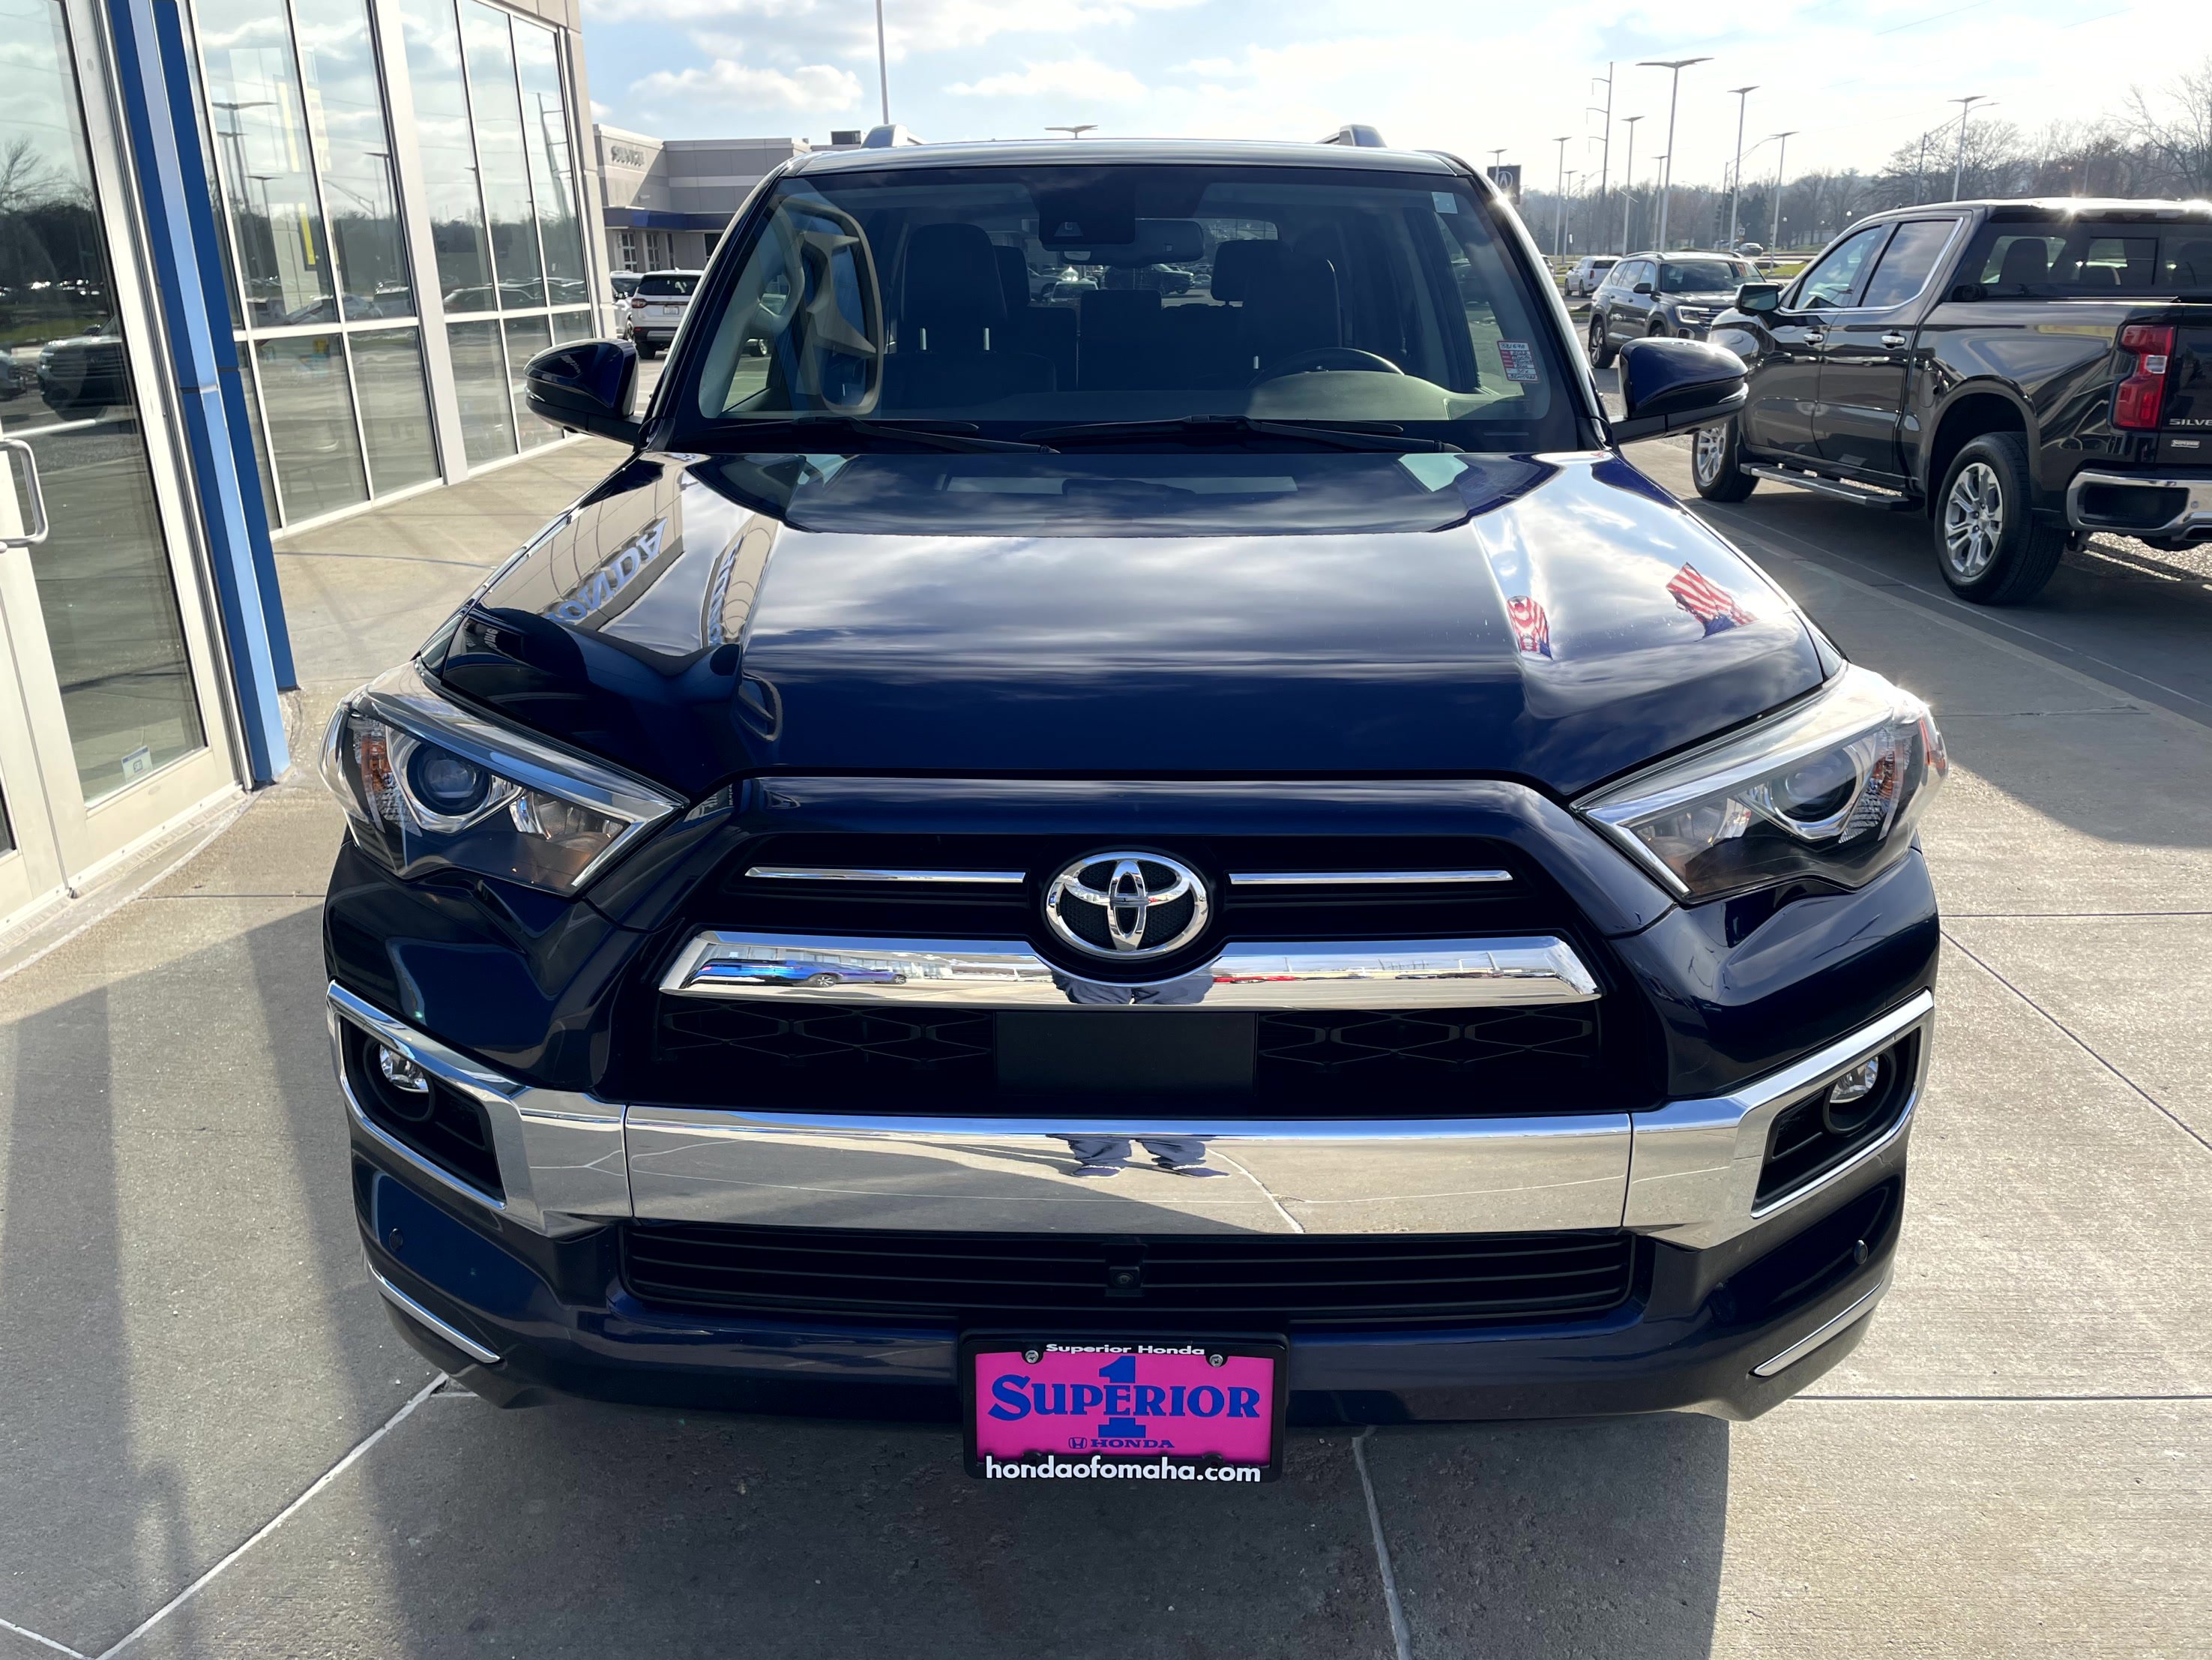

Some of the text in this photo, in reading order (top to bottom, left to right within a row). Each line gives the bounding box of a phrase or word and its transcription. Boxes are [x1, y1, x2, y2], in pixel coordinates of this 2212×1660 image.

[1046, 1344, 1205, 1355] Superior Honda
[988, 1374, 1260, 1421] SUPERIOR
[1091, 1439, 1175, 1449] HONDA
[986, 1455, 1262, 1482] hondaofomaha.com
